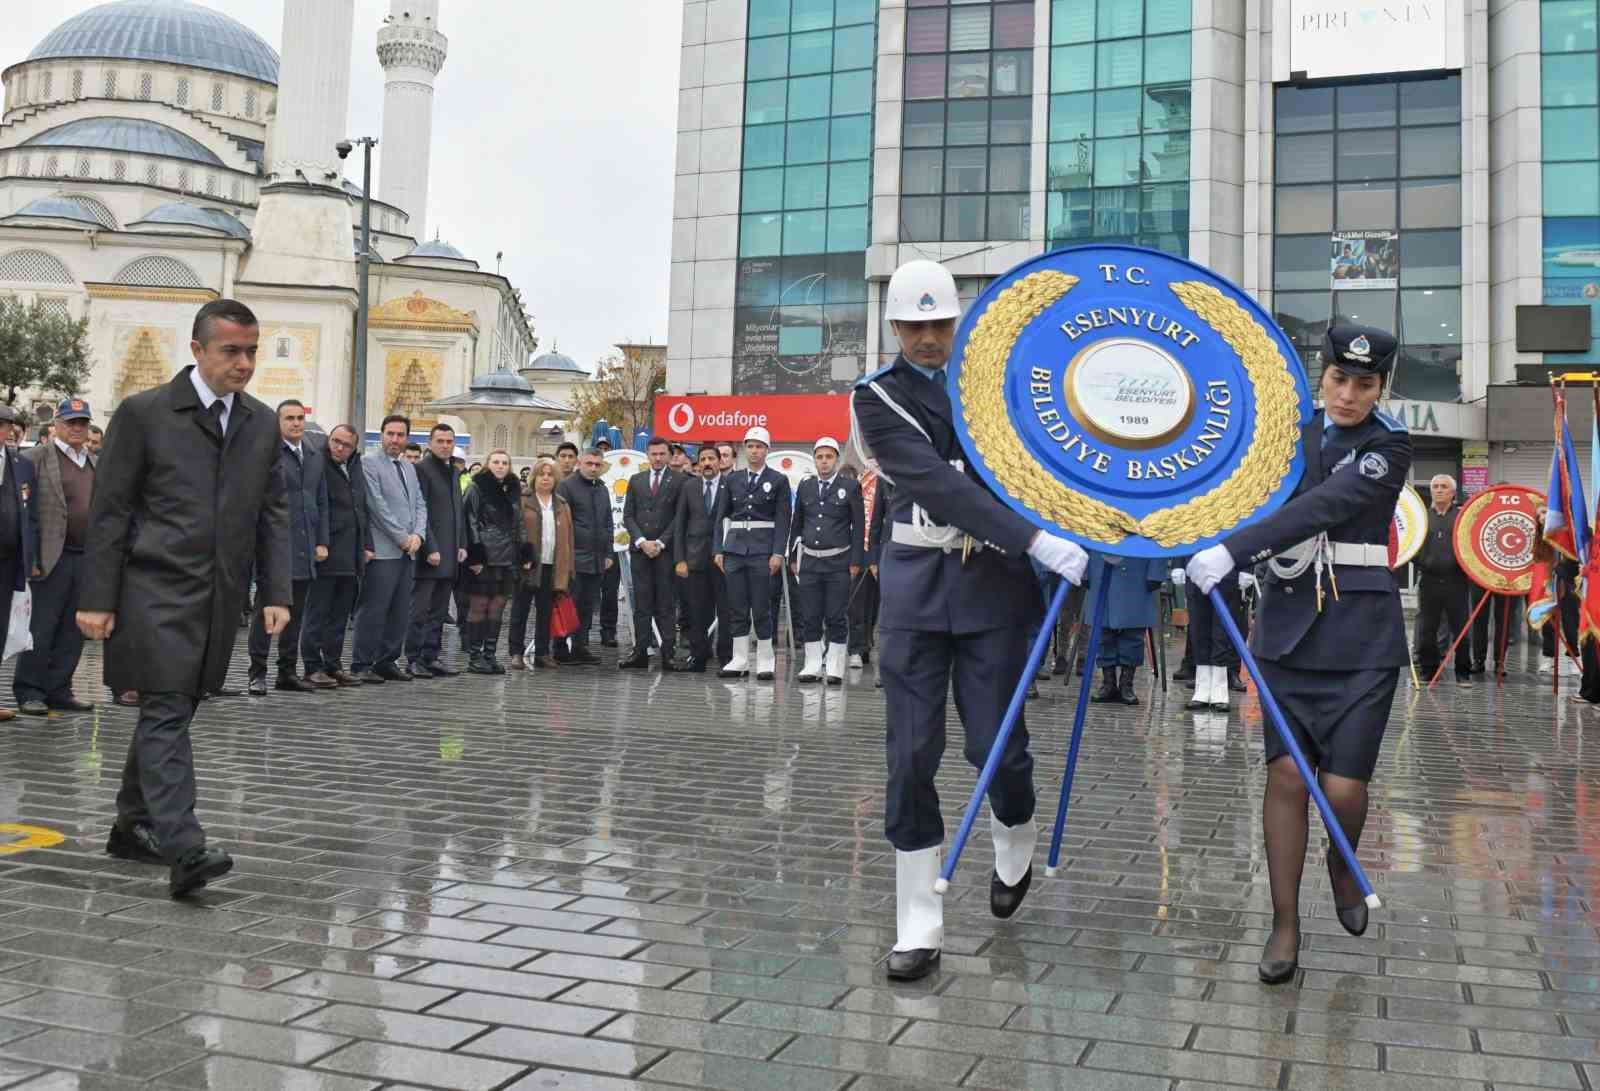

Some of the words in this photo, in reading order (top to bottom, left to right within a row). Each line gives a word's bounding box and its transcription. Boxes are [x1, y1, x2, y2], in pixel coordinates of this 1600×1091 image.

[1060, 307, 1200, 349] ESENYURT
[1118, 388, 1176, 398] ESENYURT
[698, 411, 767, 427] vodafone
[1031, 366, 1112, 474] BELEDİYE
[1128, 380, 1232, 480] BAŞKANLIĞI
[1120, 416, 1149, 425] 1989
